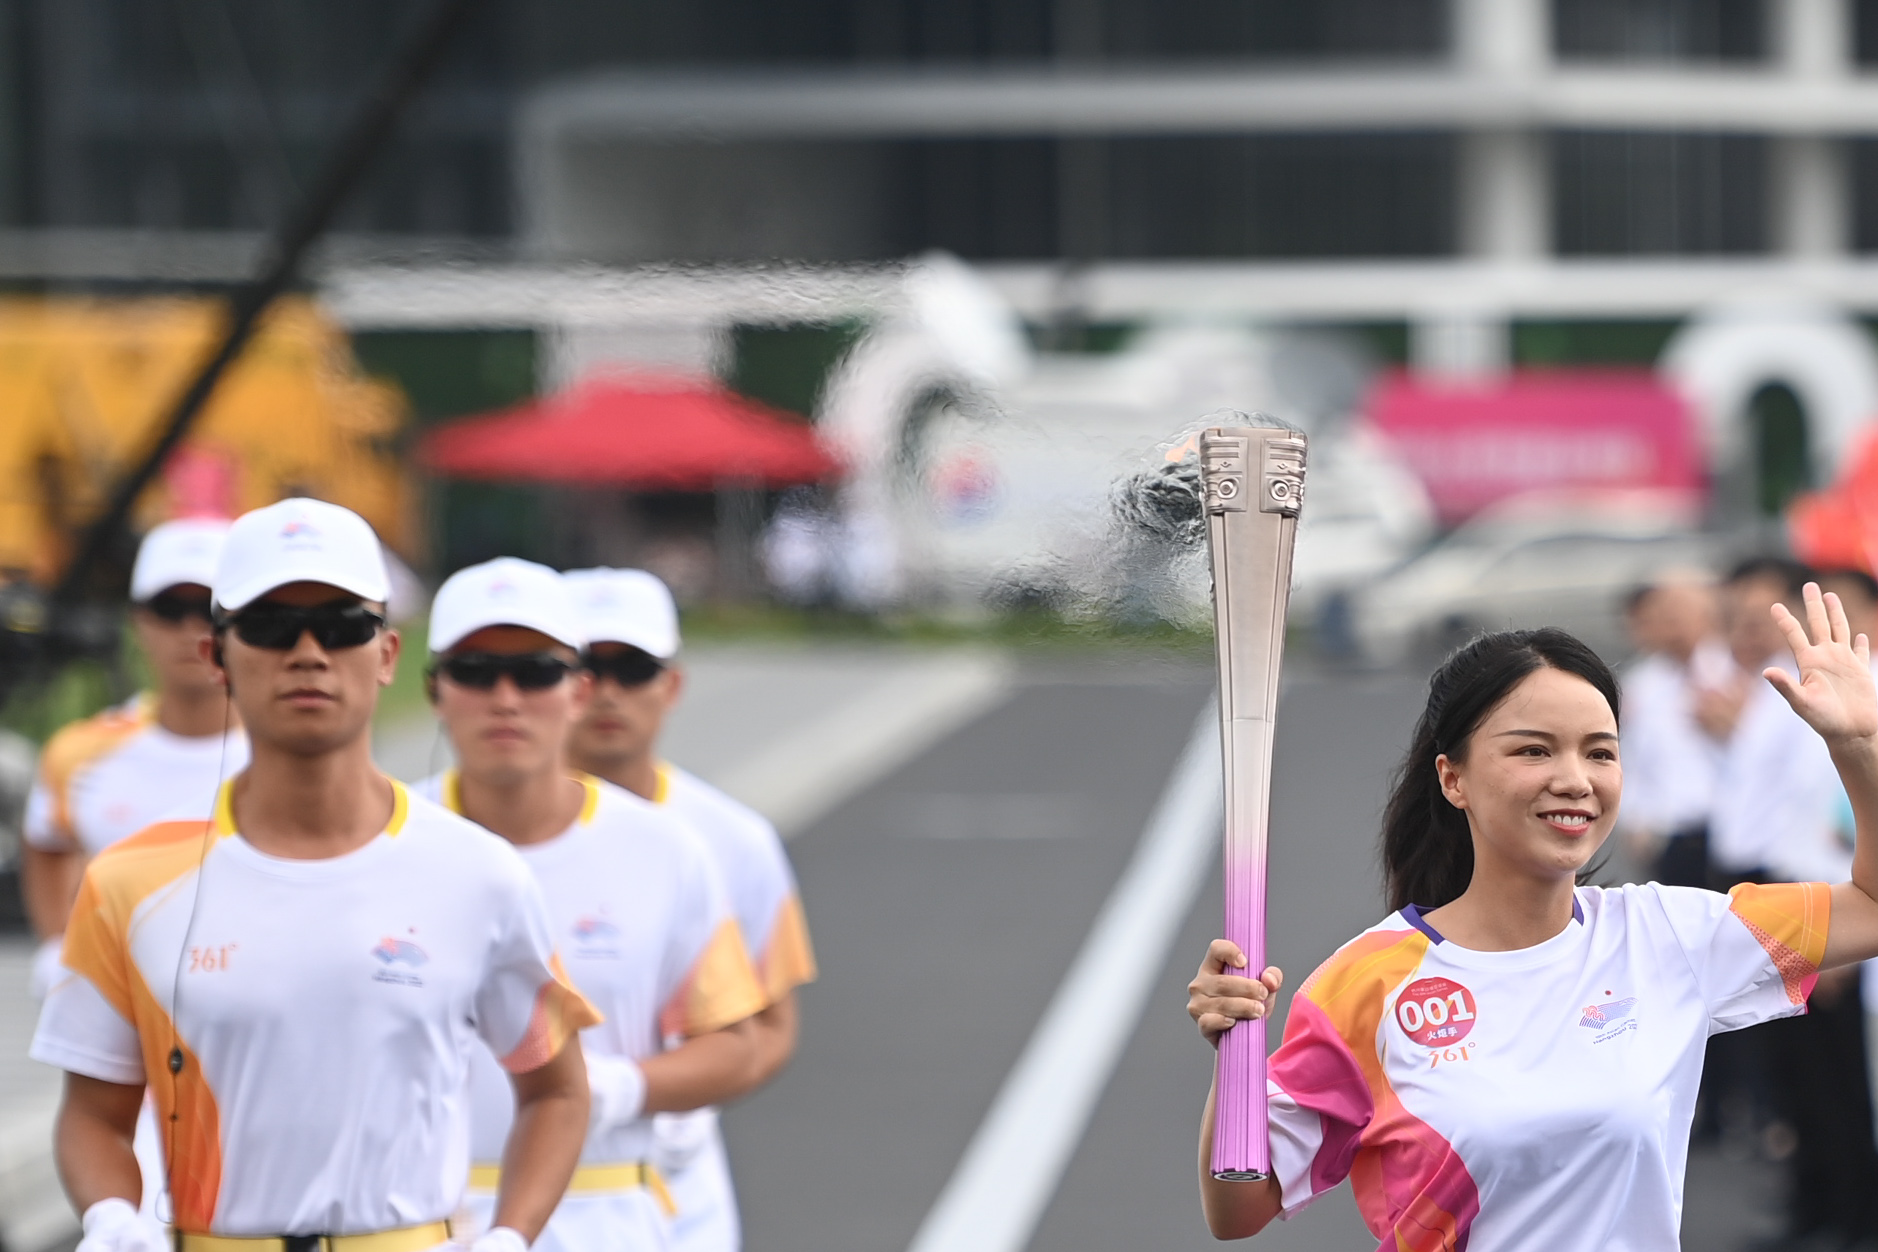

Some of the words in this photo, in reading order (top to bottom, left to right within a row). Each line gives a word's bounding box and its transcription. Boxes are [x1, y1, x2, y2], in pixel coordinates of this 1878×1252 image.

[1398, 990, 1475, 1033] 001
[1426, 1026, 1459, 1042] 火炬手
[1427, 1041, 1477, 1070] 361°
